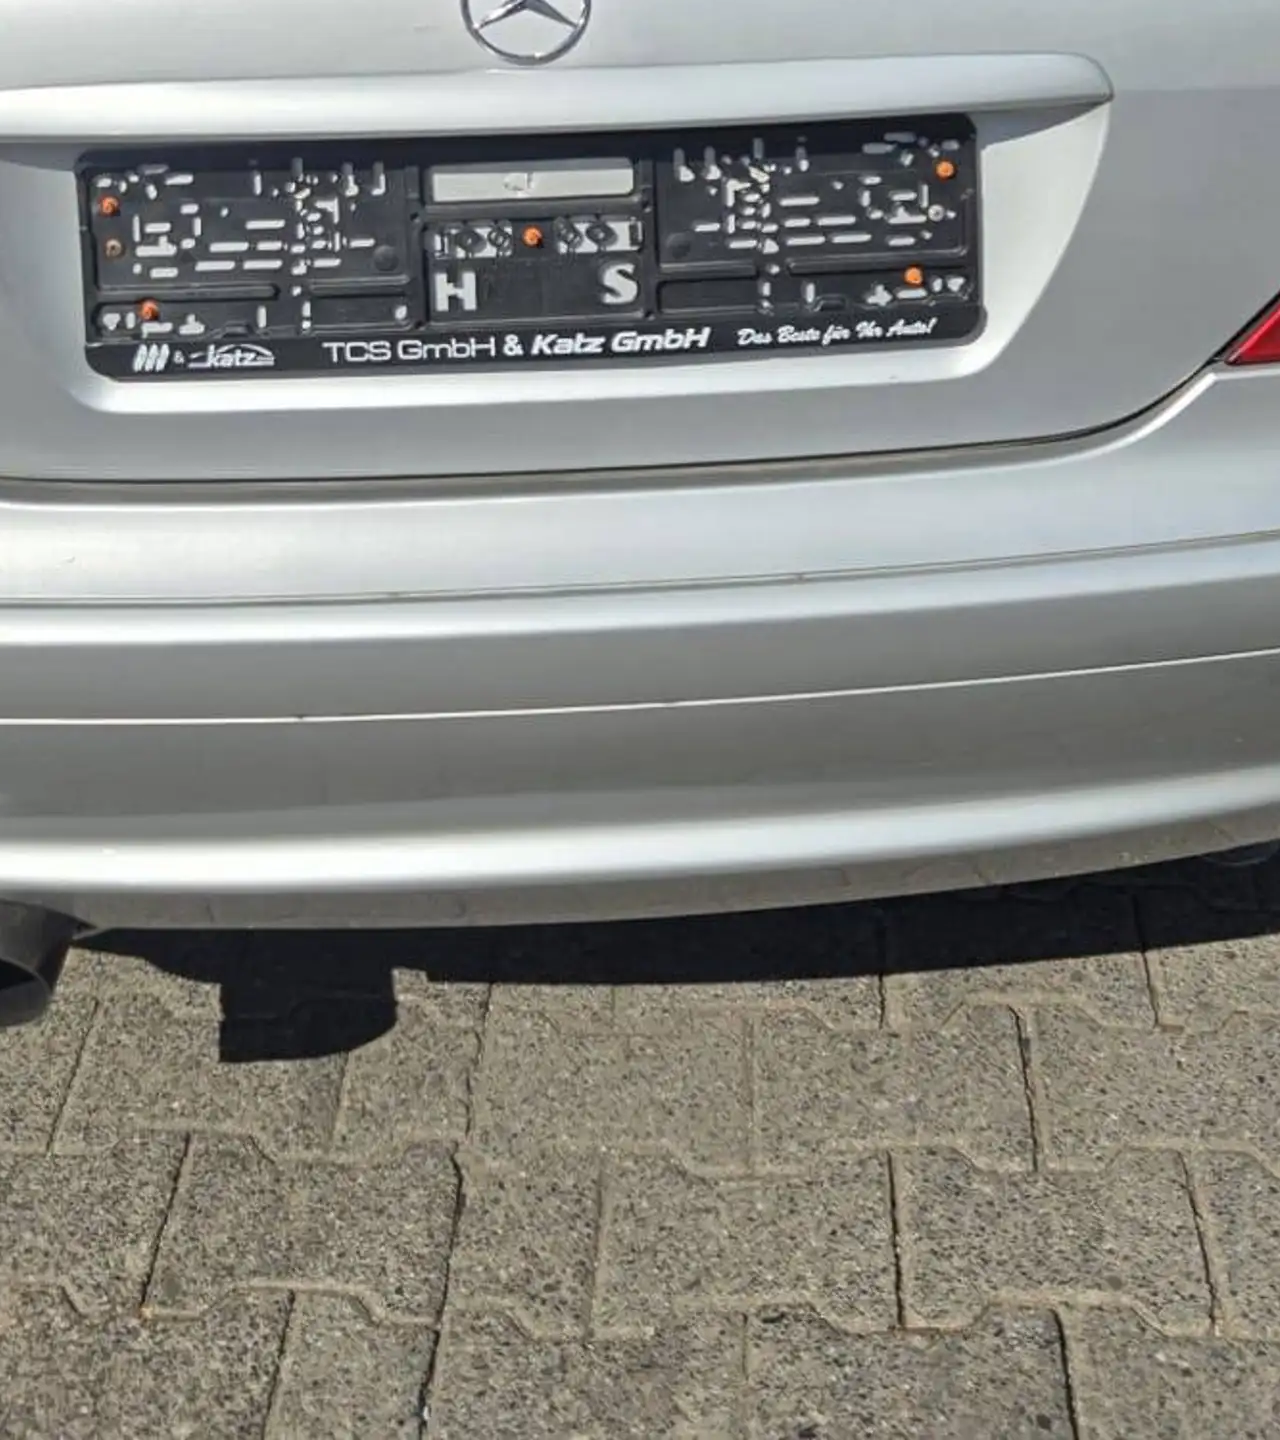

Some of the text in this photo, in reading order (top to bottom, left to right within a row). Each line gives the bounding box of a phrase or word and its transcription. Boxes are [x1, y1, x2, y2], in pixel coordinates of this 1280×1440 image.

[322, 326, 712, 363] TCS GmbH & Katz GmbH
[736, 317, 938, 347] Das Beste für Ihr Auto!
